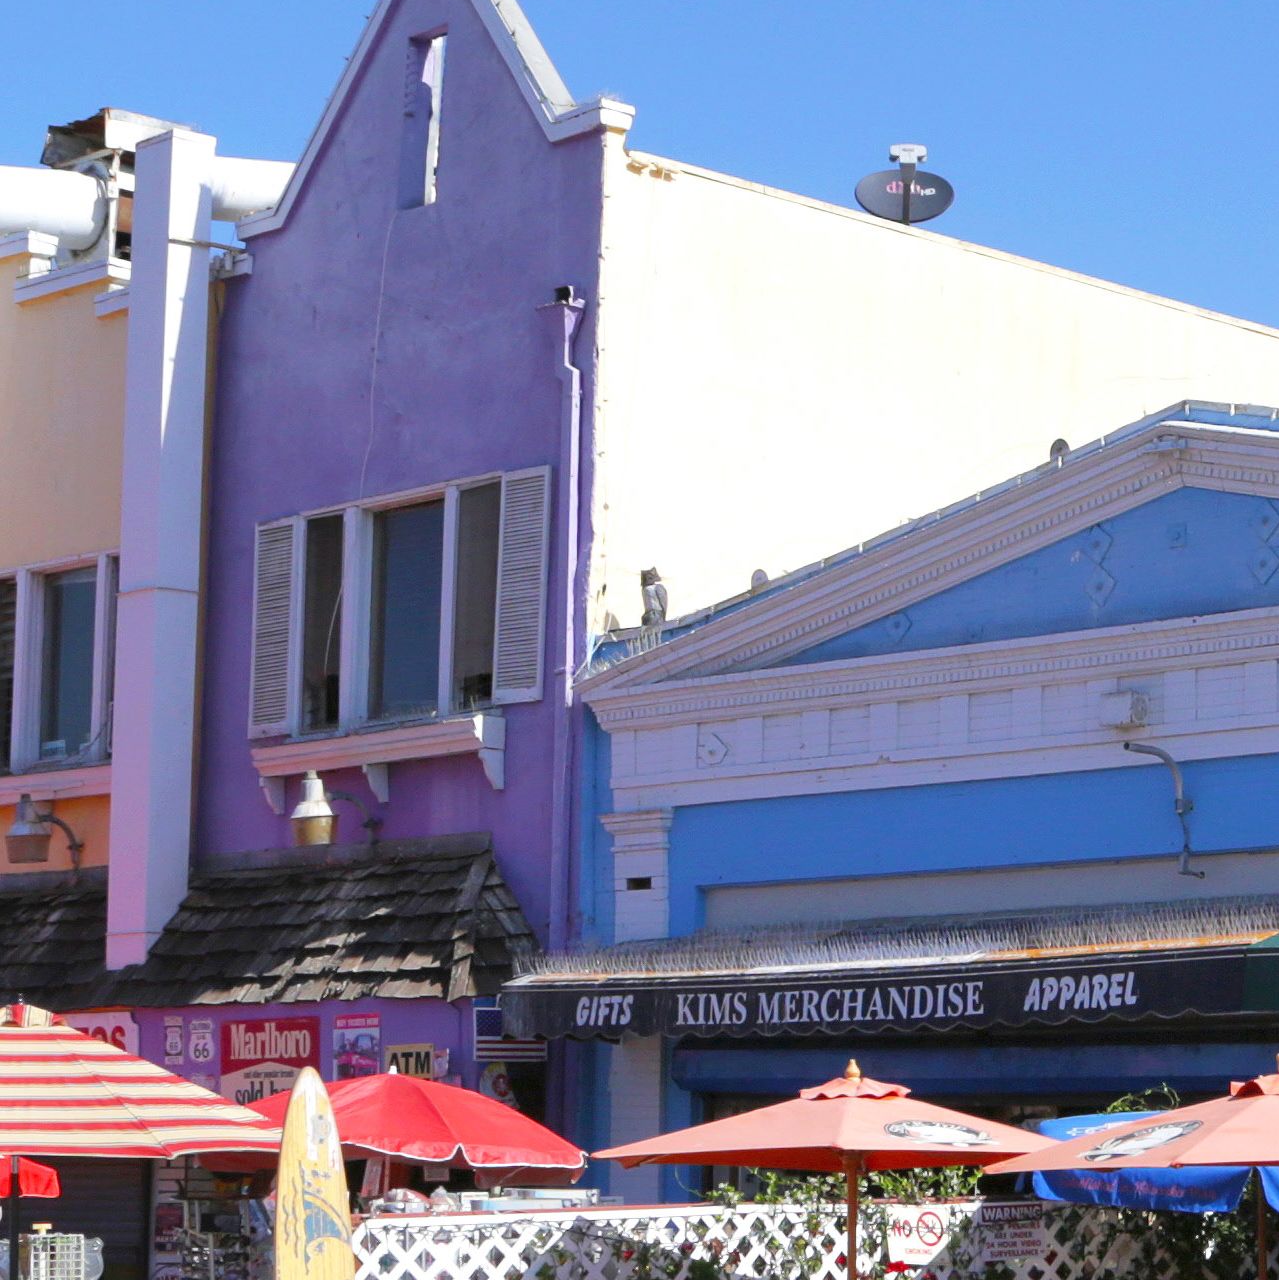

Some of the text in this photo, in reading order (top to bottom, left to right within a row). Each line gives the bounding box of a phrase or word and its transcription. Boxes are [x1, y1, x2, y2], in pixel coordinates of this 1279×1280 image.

[576, 971, 1139, 1026] GIFTS KIMS MERCHANDISE APPAREL
[193, 1042, 210, 1059] 66
[230, 1022, 311, 1060] Marlboro
[389, 1051, 430, 1075] ATM
[983, 1205, 1042, 1220] WARNING
